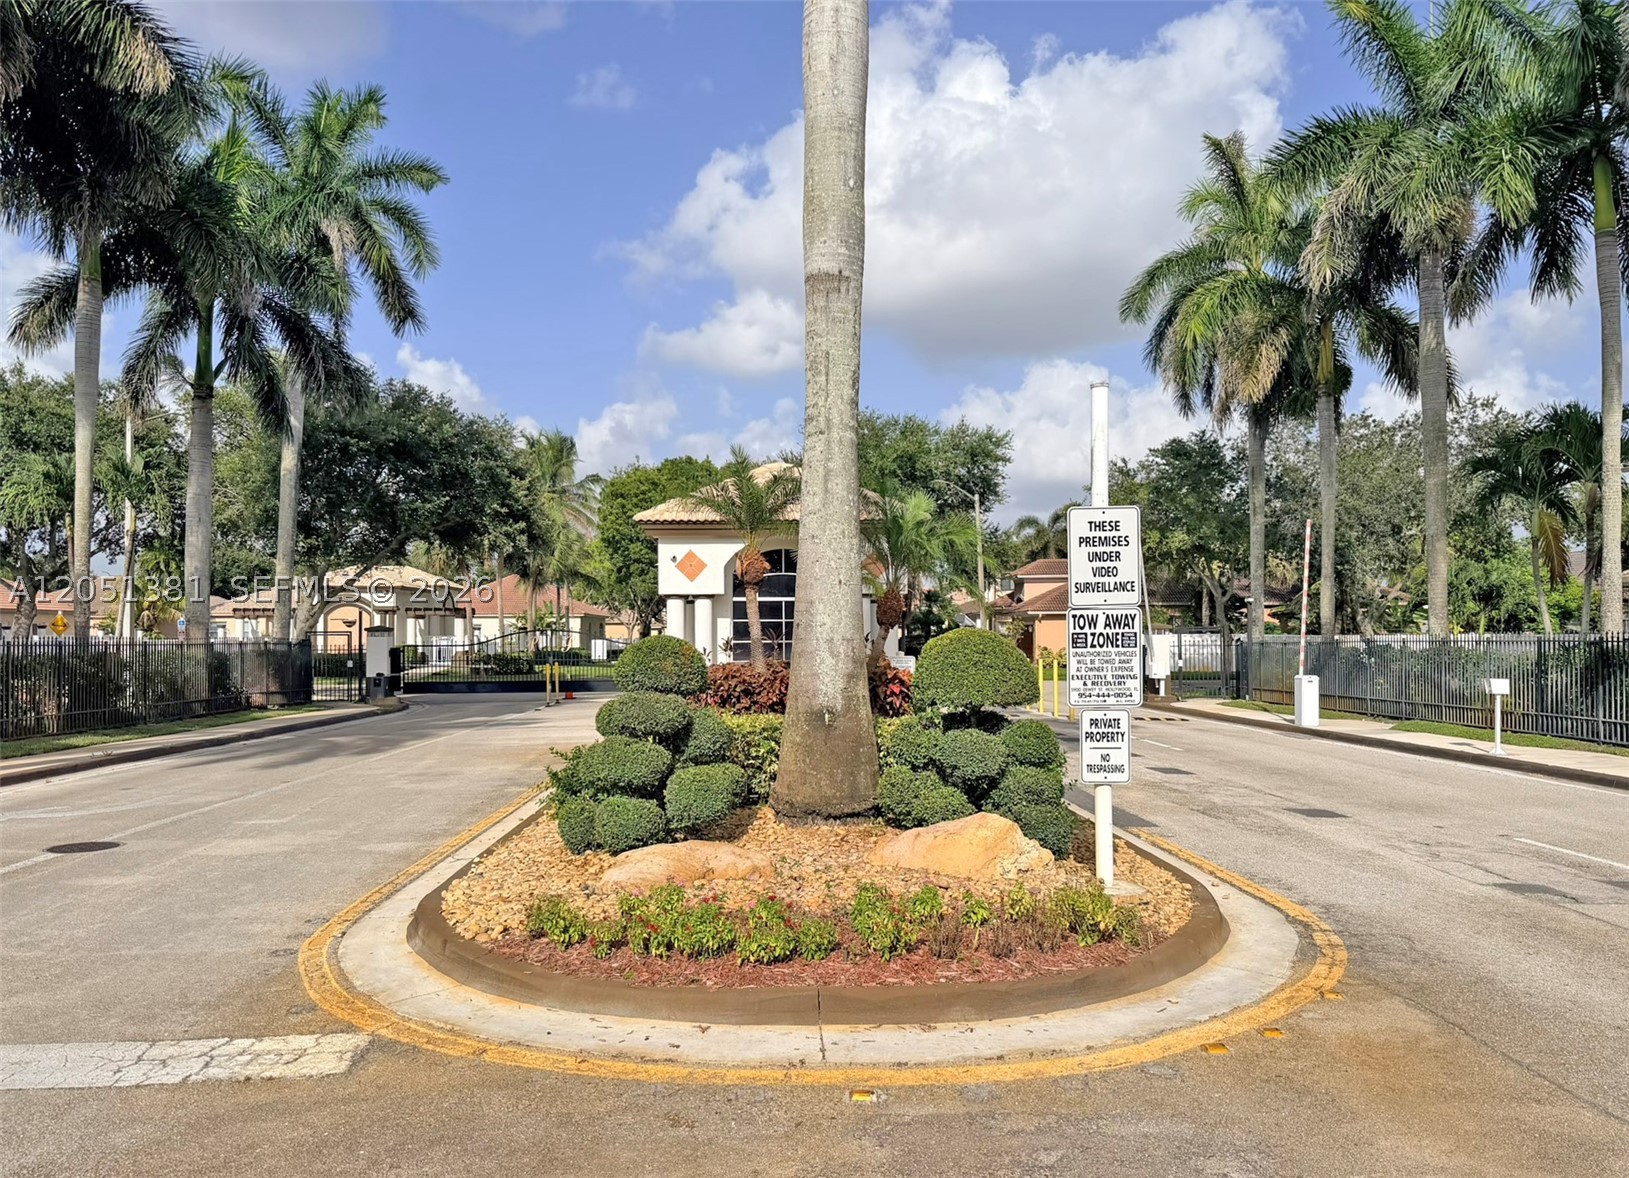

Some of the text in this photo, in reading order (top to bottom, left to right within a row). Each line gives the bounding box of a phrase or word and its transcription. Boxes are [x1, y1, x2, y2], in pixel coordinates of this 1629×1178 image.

[1087, 520, 1121, 532] THESE
[1078, 535, 1130, 548] PREMISES
[1087, 551, 1122, 563] UNDER
[1091, 566, 1119, 578] VIDEO
[1074, 581, 1136, 594] SURVEILLANCE
[1072, 613, 1137, 630] TOW AWAY
[1090, 632, 1120, 648] ZONE
[1072, 650, 1137, 658] UNAUTHORIZED VEHICLES
[1076, 658, 1088, 666] WILL
[1089, 658, 1096, 666] BE
[1097, 658, 1117, 666] TOWED
[1089, 718, 1121, 729] PRIVATE
[1085, 731, 1126, 743] PROPERTY
[1100, 753, 1111, 763] NO
[1086, 763, 1125, 774] TRESPASSING
